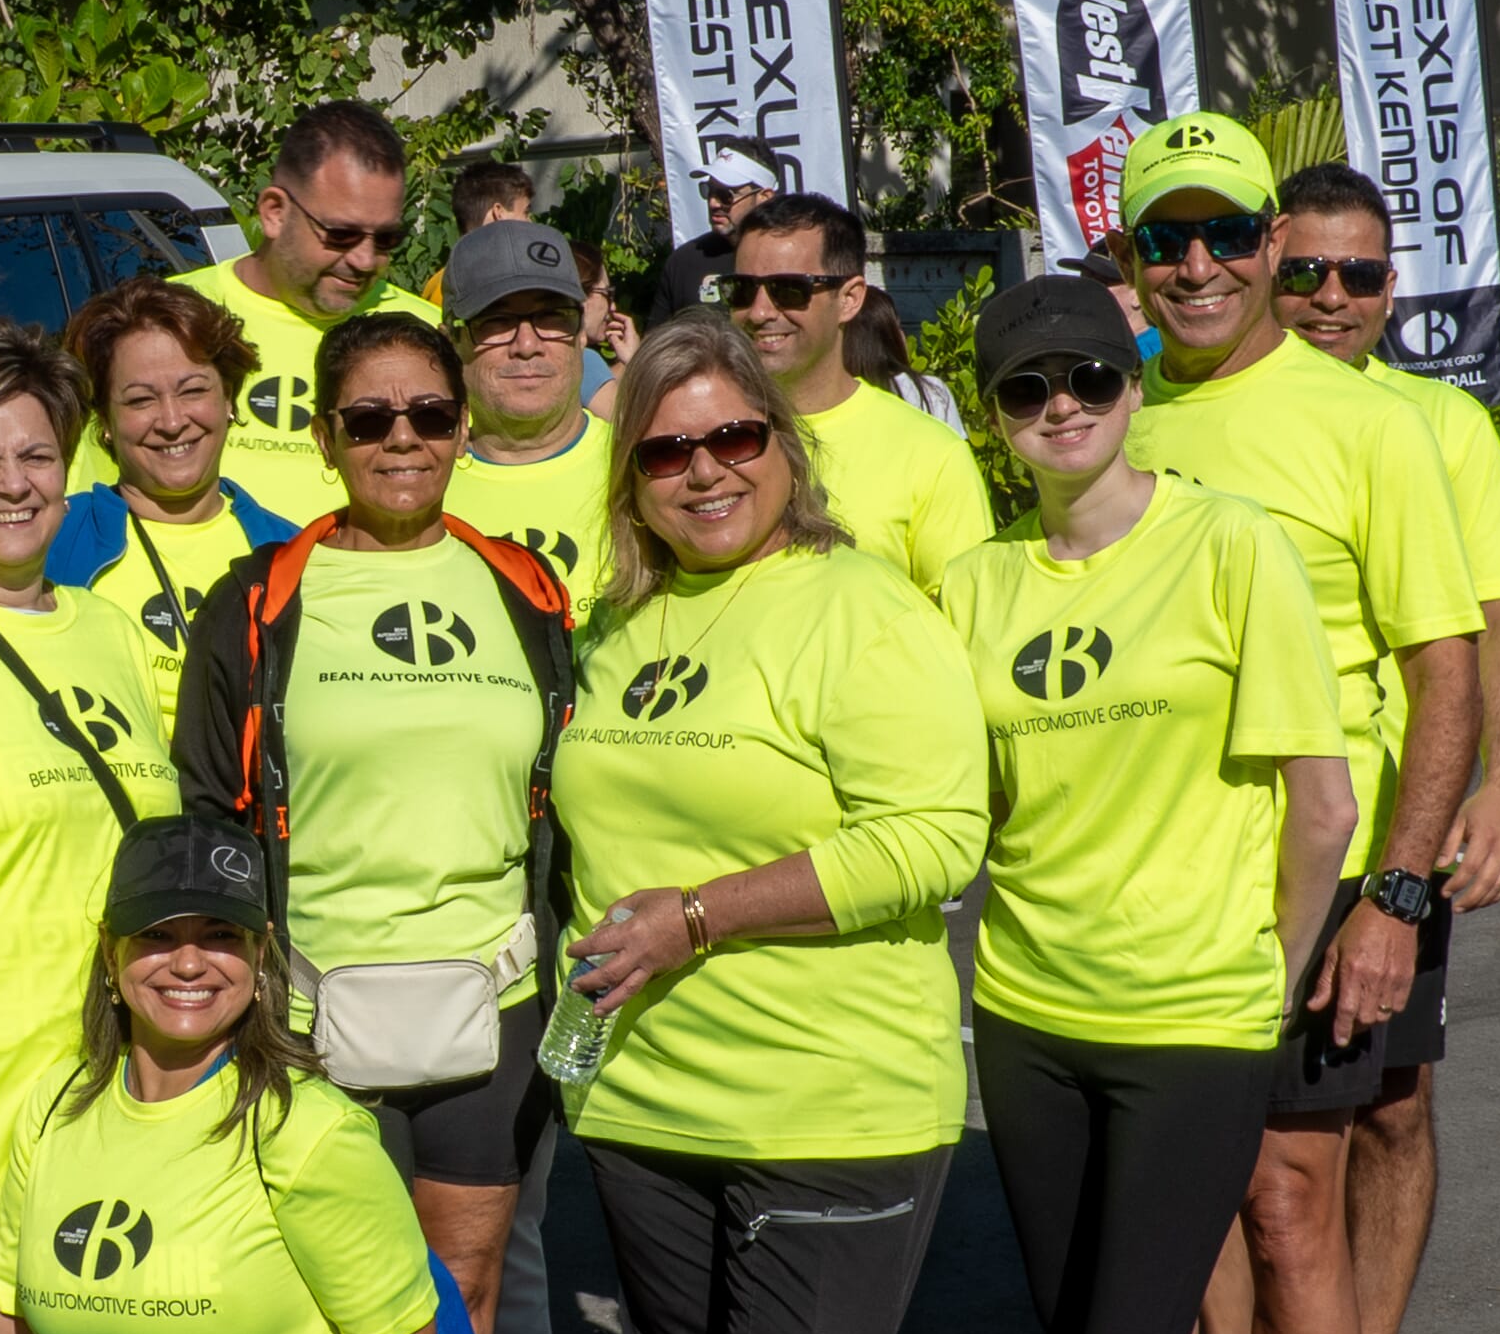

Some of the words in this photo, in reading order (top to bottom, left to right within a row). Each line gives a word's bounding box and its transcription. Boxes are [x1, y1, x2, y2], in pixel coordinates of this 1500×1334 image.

[1083, 157, 1107, 245] TOYOTA
[1432, 177, 1468, 266] OF
[1454, 353, 1486, 367] GROUP
[318, 671, 365, 683] BEAN
[369, 671, 484, 684] AUTOMOTIVE
[1010, 707, 1106, 737] AUTOMOTIVE
[589, 729, 674, 746] AUTOMOTIVE
[29, 768, 67, 789] BEAN
[38, 1291, 138, 1316] AUTOMOTIVE
